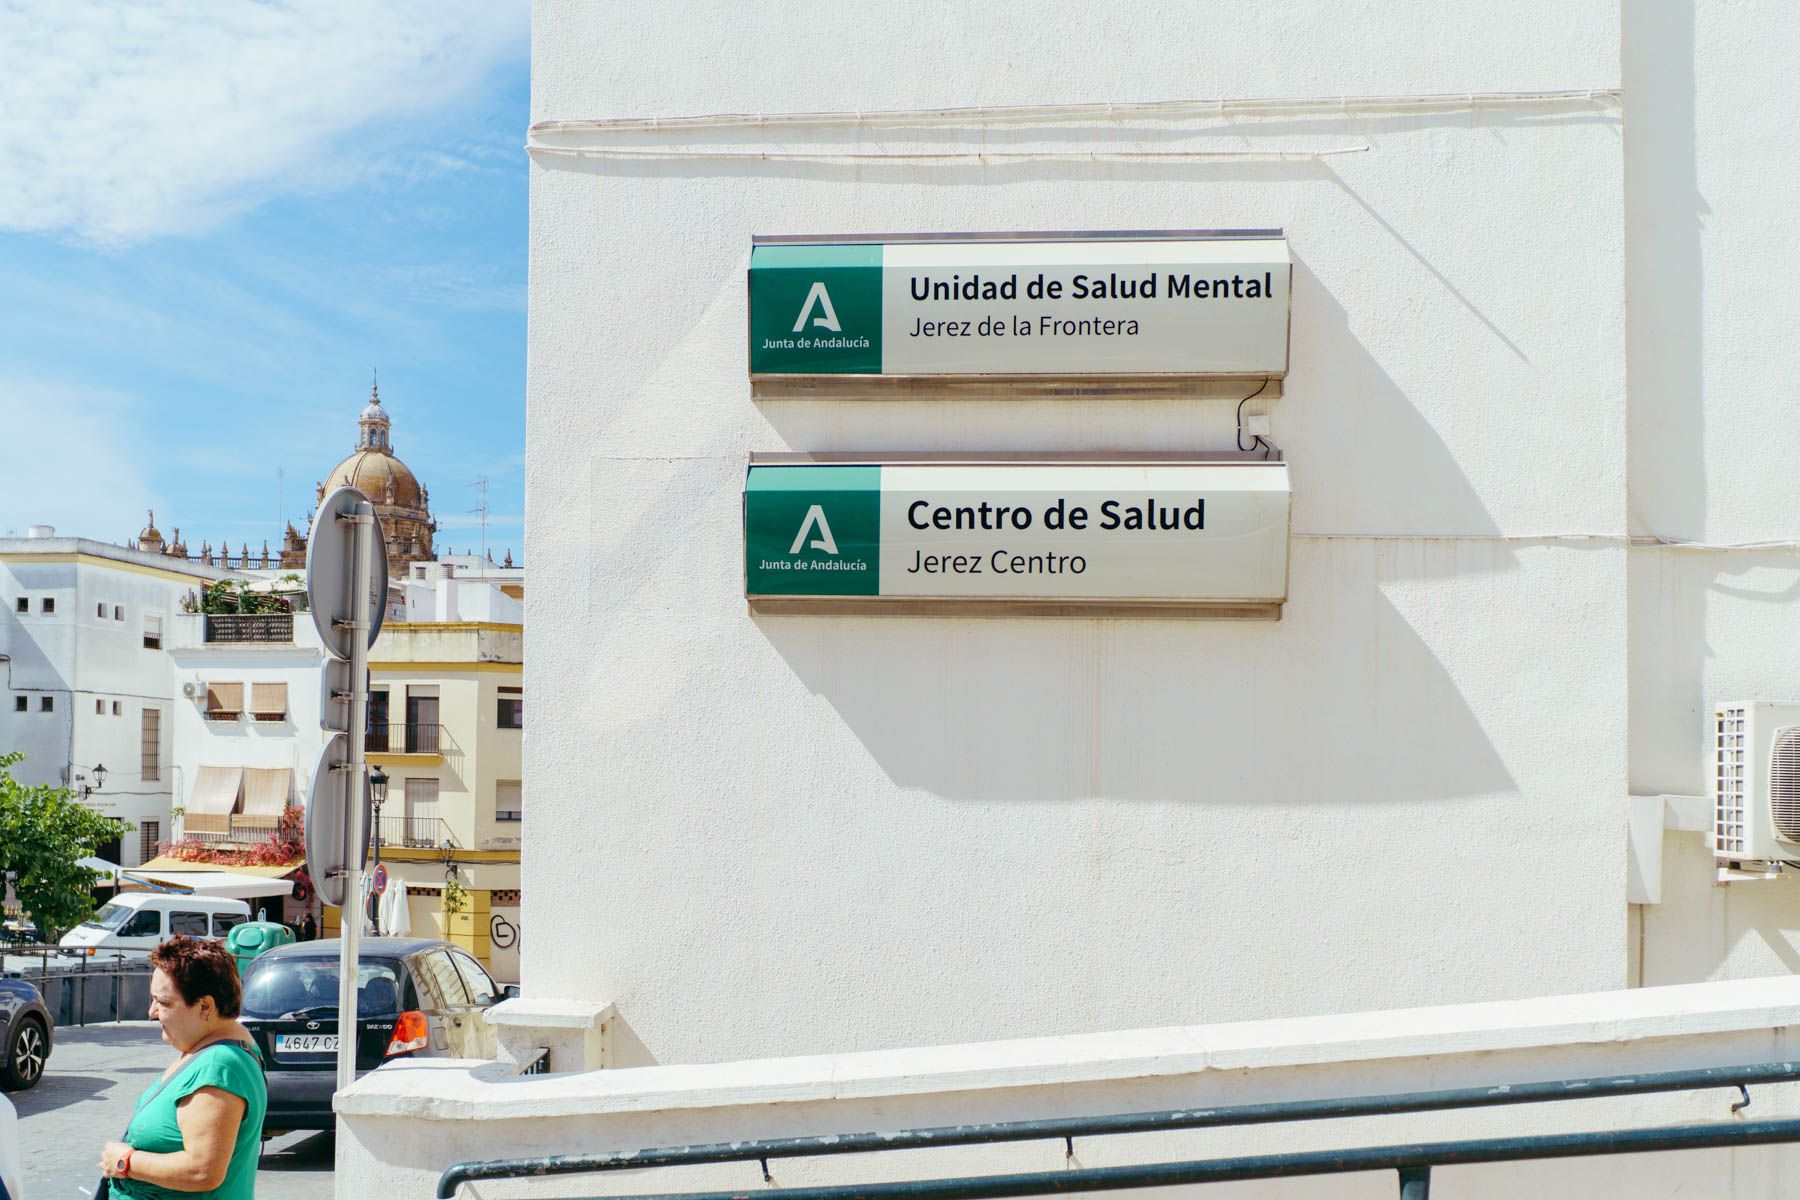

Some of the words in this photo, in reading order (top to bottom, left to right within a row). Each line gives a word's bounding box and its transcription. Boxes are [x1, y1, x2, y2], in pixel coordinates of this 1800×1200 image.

[911, 274, 1017, 301] Unidad
[1026, 273, 1063, 300] de
[1071, 273, 1157, 300] Salud
[1167, 271, 1273, 299] Mental
[909, 317, 971, 337] Jerez
[977, 315, 1006, 337] de
[1013, 315, 1031, 336] la
[1040, 316, 1139, 336] Frontera
[762, 338, 795, 349] Junta
[796, 337, 811, 349] de
[813, 335, 870, 348] Andalucía
[907, 500, 1033, 530] Centro
[1043, 499, 1089, 531] de
[1099, 498, 1205, 531] Salud
[758, 559, 792, 570] Junta
[793, 559, 808, 570] de
[809, 558, 867, 571] Andalucía
[907, 550, 982, 574] Jerez
[990, 550, 1087, 574] Centro
[284, 1037, 320, 1050] 4647
[323, 1036, 339, 1050] CZ
